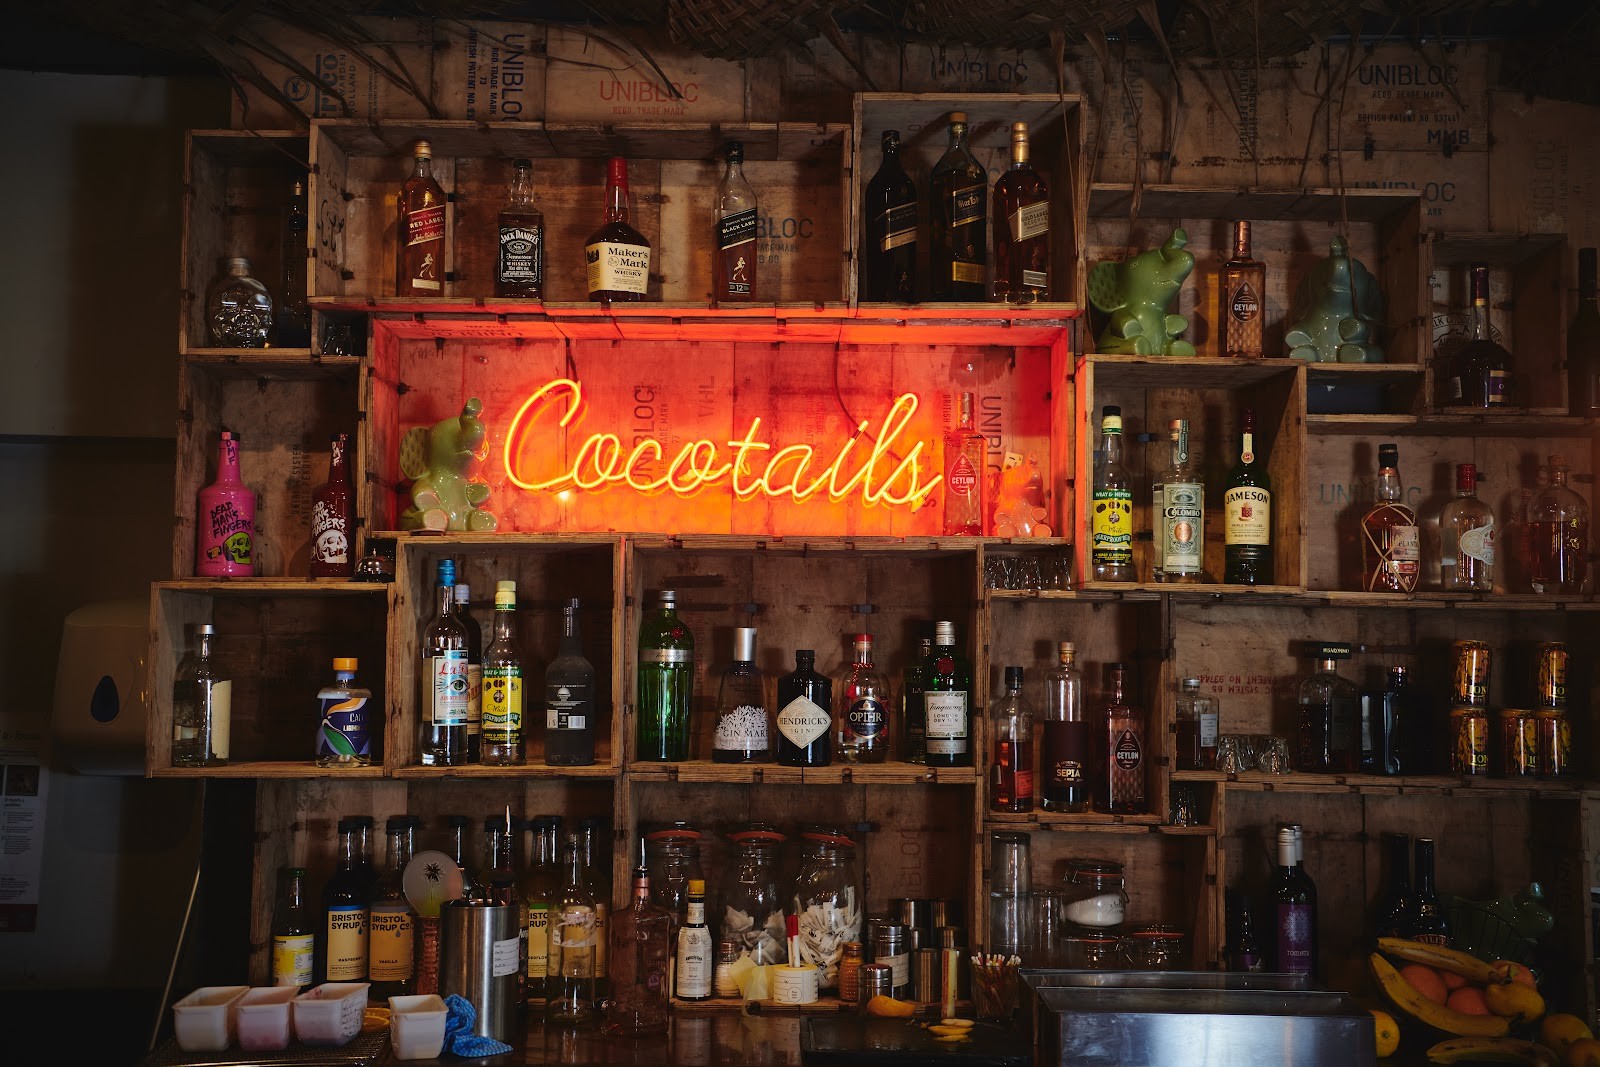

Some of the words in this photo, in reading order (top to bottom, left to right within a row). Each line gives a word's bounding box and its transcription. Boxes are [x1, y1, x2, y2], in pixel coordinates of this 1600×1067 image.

[467, 61, 476, 90] PATENT
[490, 65, 498, 89] TRADE
[1359, 64, 1459, 86] UNIBLOC
[600, 80, 699, 102] UNIBLOC
[489, 92, 498, 115] MARK
[1427, 128, 1470, 144] MMB
[410, 221, 424, 229] RED
[425, 216, 444, 225] LABEL
[756, 217, 814, 239] BLOC
[722, 225, 740, 235] BLACK
[501, 232, 516, 244] JACK
[608, 247, 649, 259] Maker's
[620, 258, 648, 269] Mark
[1233, 303, 1257, 312] CEYLON
[504, 378, 943, 503] Cocotails
[291, 444, 301, 475] SYSTEM
[951, 476, 975, 485] CEYLON
[1226, 491, 1269, 505] JAMESON
[210, 501, 233, 519] DEAD
[1165, 507, 1201, 518] COLOMBO
[212, 509, 239, 529] MAN'S
[213, 519, 252, 539] FINGERS
[1228, 685, 1259, 694] SYSTEM
[779, 717, 828, 726] HENDRICK'S
[850, 711, 883, 723] OPIHR
[723, 730, 741, 738] GIN
[1116, 751, 1139, 760] CEYLON
[1056, 768, 1081, 778] SEPIA
[331, 912, 366, 922] BRISTOL
[371, 915, 406, 924] BRISTOL
[332, 921, 360, 930] SYRUP
[372, 923, 398, 932] SYRUP
[530, 920, 547, 928] RUP
